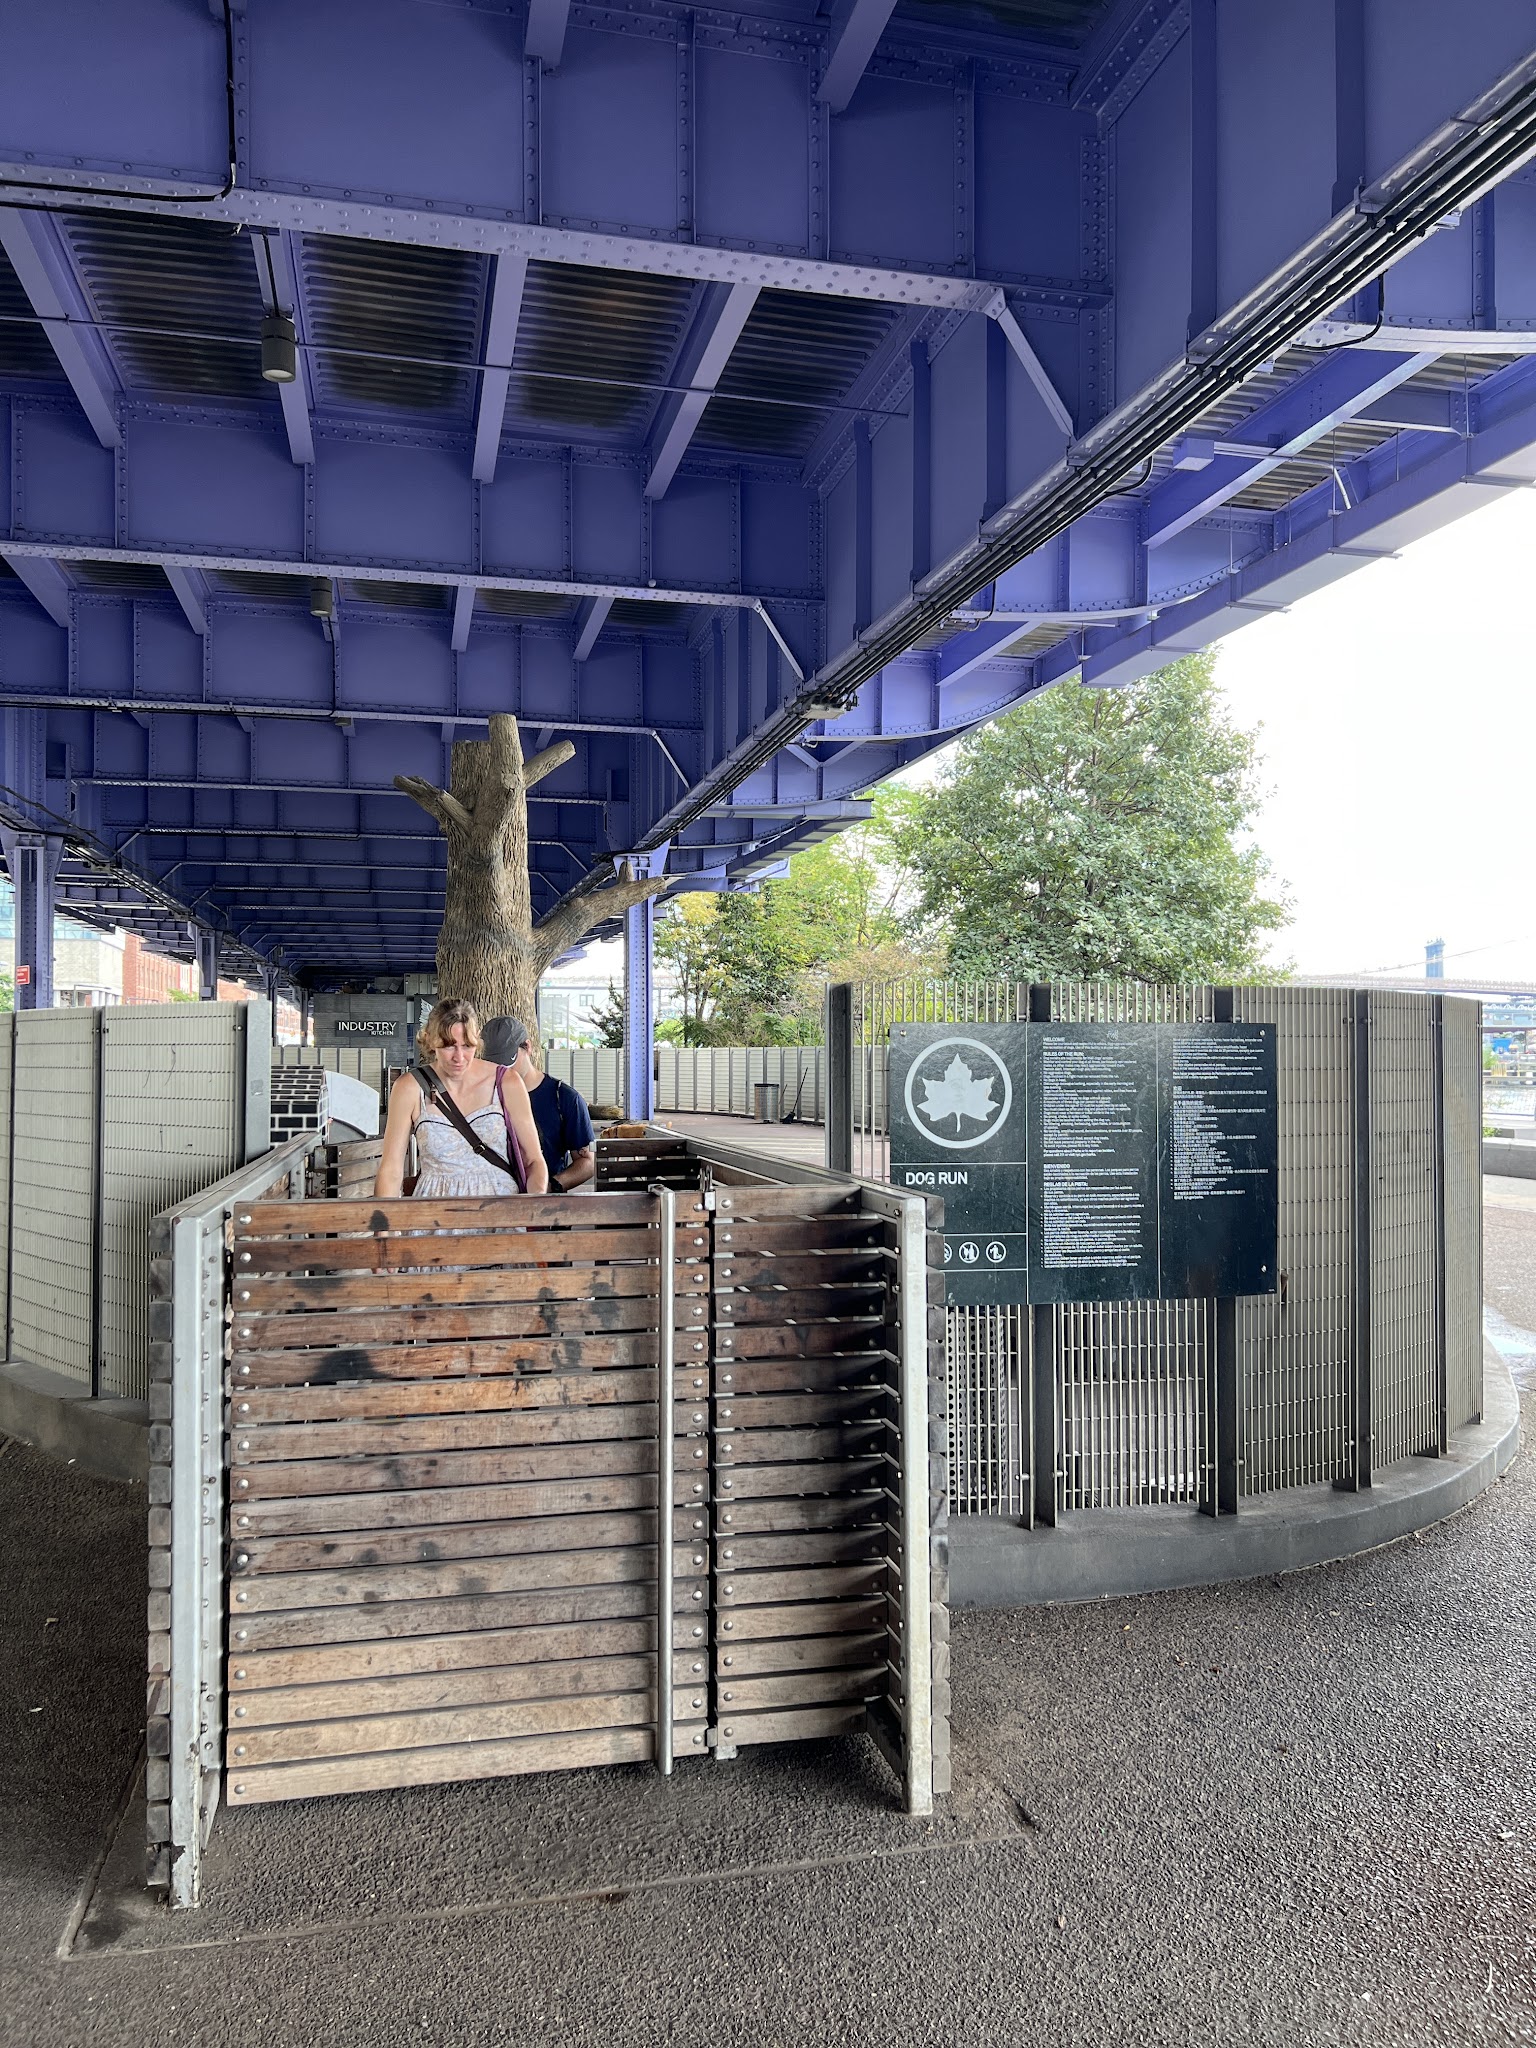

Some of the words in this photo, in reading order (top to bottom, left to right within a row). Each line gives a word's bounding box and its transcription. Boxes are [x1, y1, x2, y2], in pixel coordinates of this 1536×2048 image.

[338, 1021, 397, 1031] INDUSTRY
[905, 1171, 935, 1185] DOG
[938, 1171, 968, 1185] RUN
